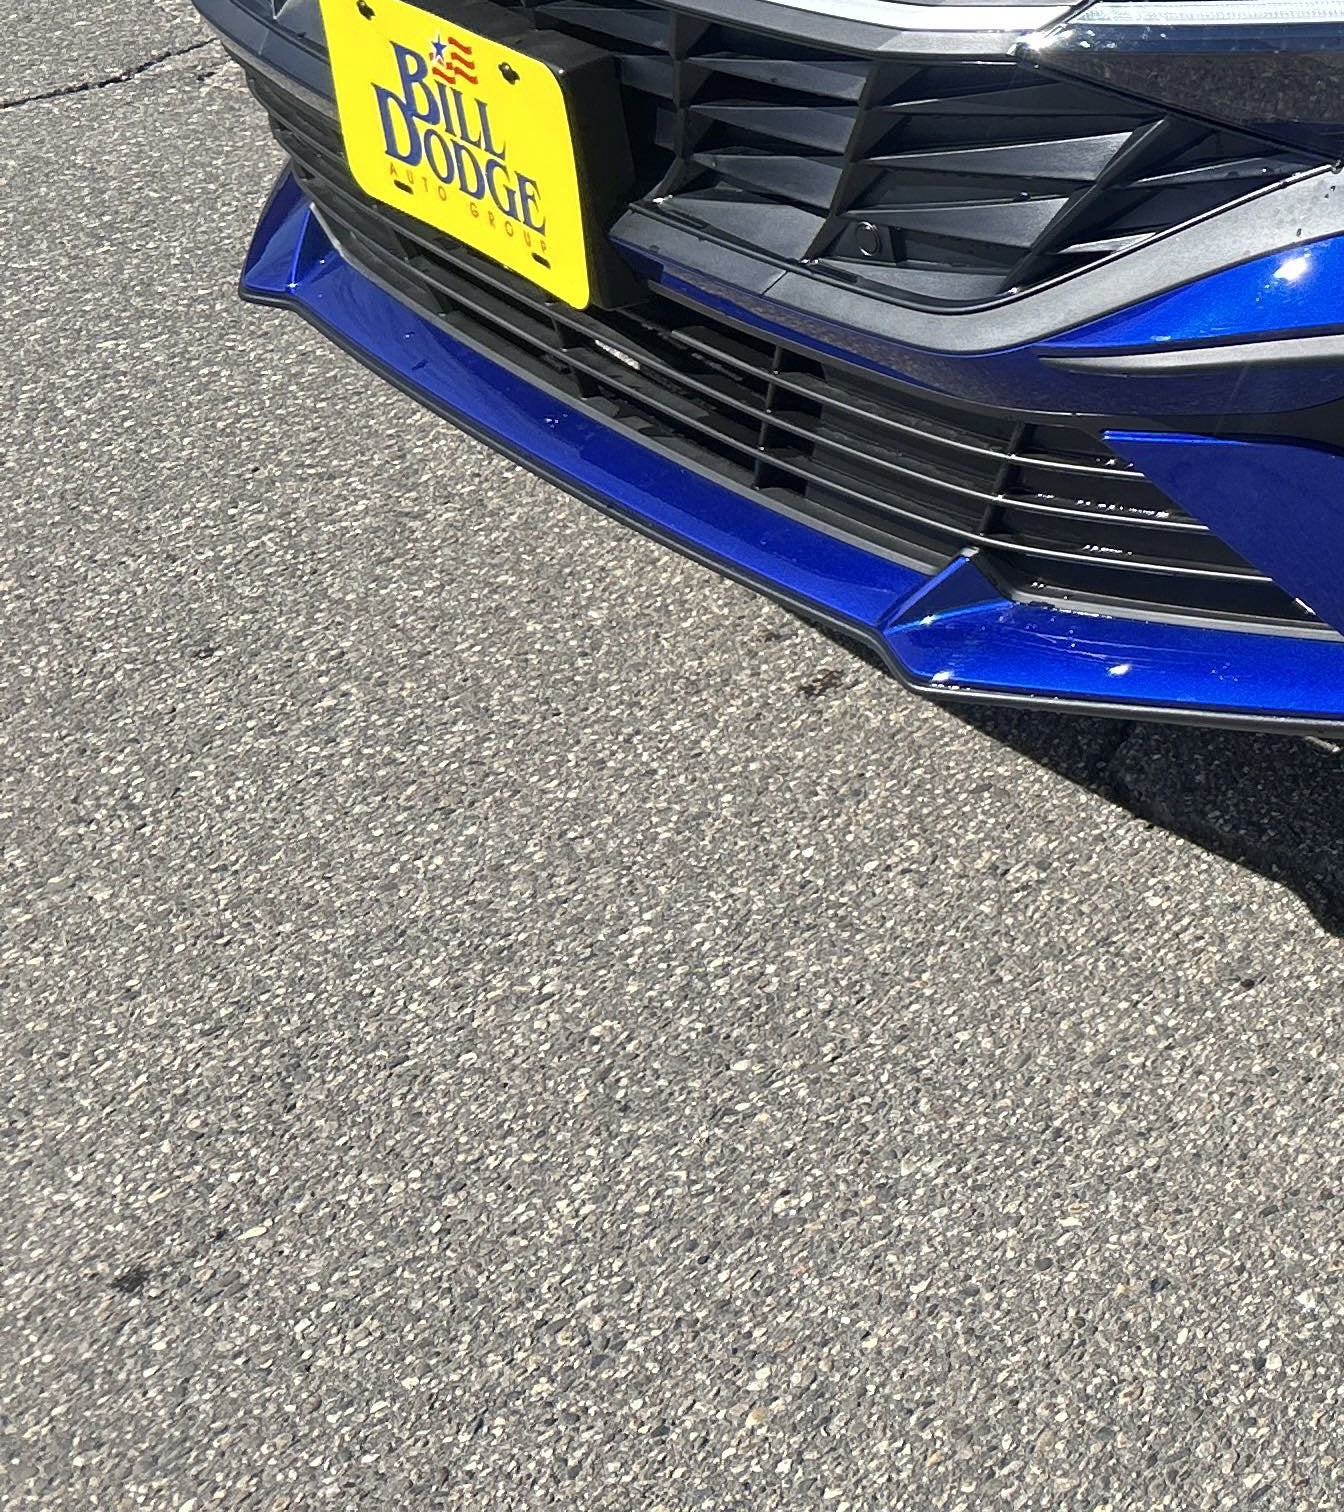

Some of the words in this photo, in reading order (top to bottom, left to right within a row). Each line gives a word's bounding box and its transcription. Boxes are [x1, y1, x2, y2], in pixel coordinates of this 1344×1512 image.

[370, 82, 546, 237] DODGE
[389, 40, 506, 160] BILL
[389, 162, 448, 201] AUTO
[469, 202, 548, 252] GROUP
